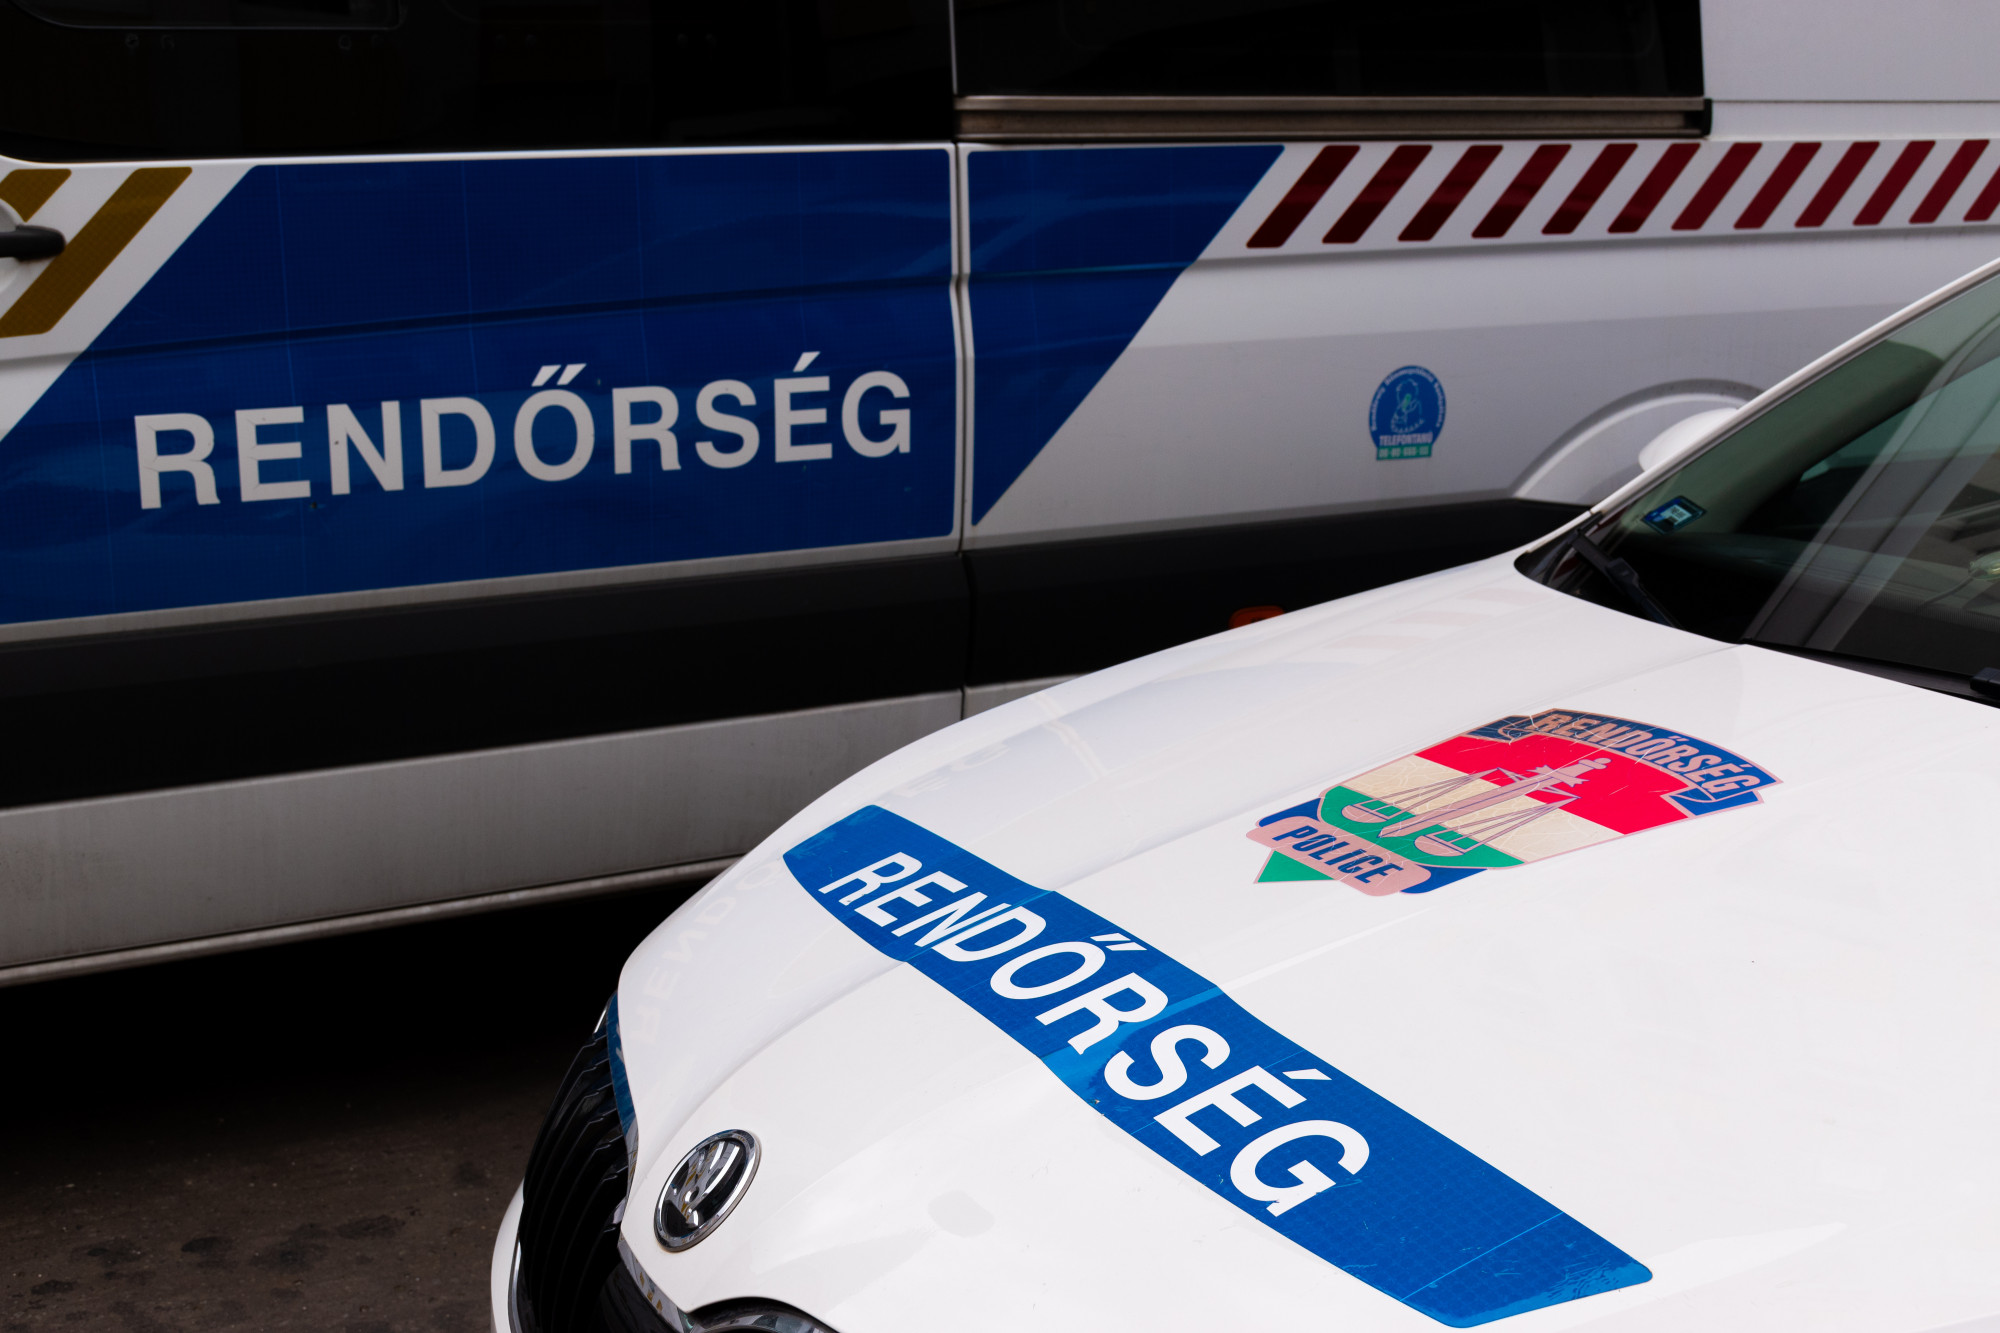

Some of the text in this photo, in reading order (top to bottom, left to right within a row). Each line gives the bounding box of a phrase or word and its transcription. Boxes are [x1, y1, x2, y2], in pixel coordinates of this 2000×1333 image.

[134, 351, 911, 509] RENDŐRSÉG
[1524, 712, 1761, 794] RENDŐRSÉG
[1272, 825, 1404, 884] POLICE
[818, 852, 1370, 1217] RENDŐRSÉG
